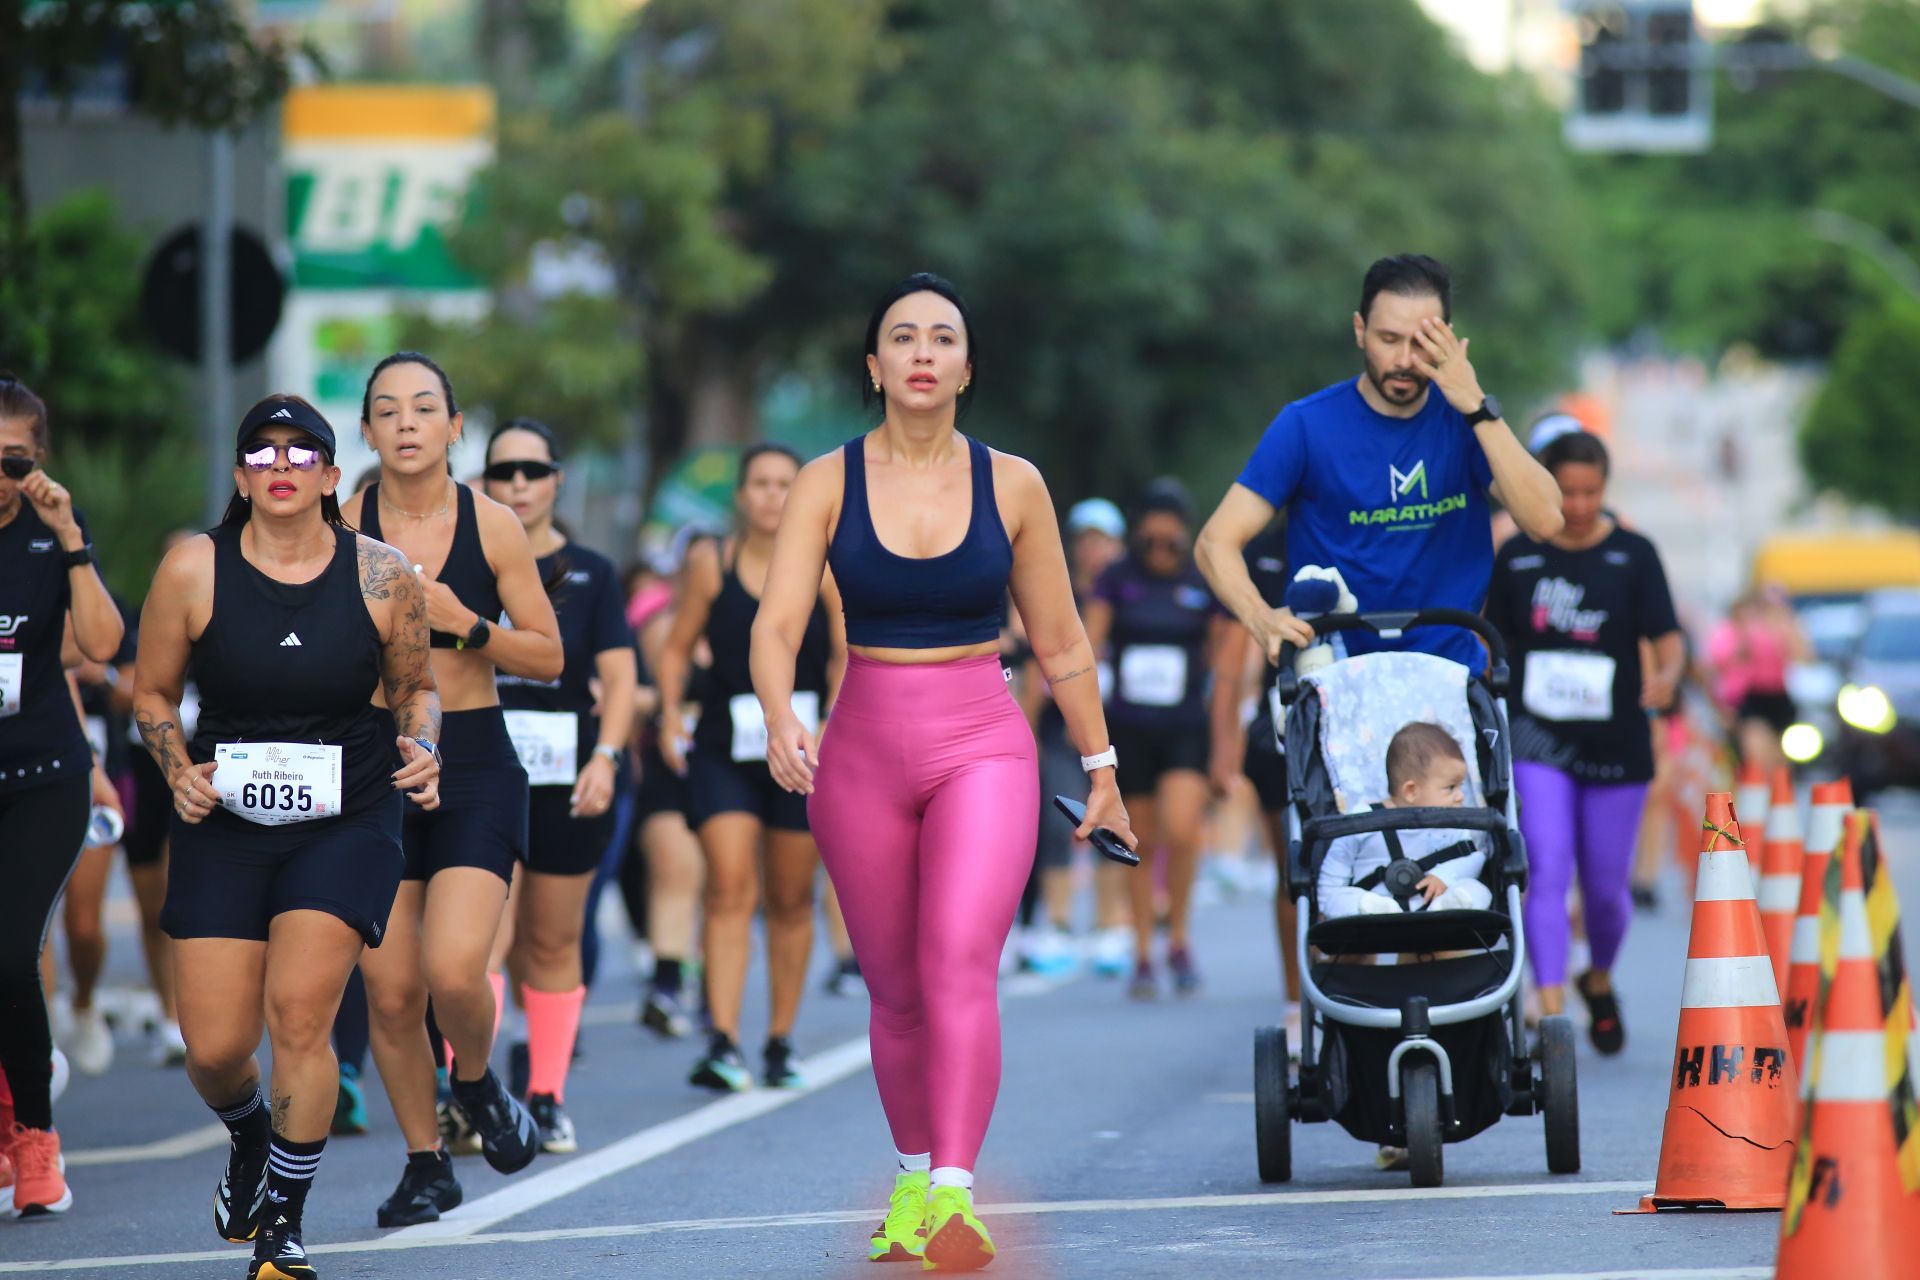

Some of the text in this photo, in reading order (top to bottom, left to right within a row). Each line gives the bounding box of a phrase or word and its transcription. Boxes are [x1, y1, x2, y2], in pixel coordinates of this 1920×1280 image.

[1349, 493, 1467, 525] MARATHON
[252, 770, 304, 781] Ruth Ribeiro
[243, 783, 312, 812] 6035
